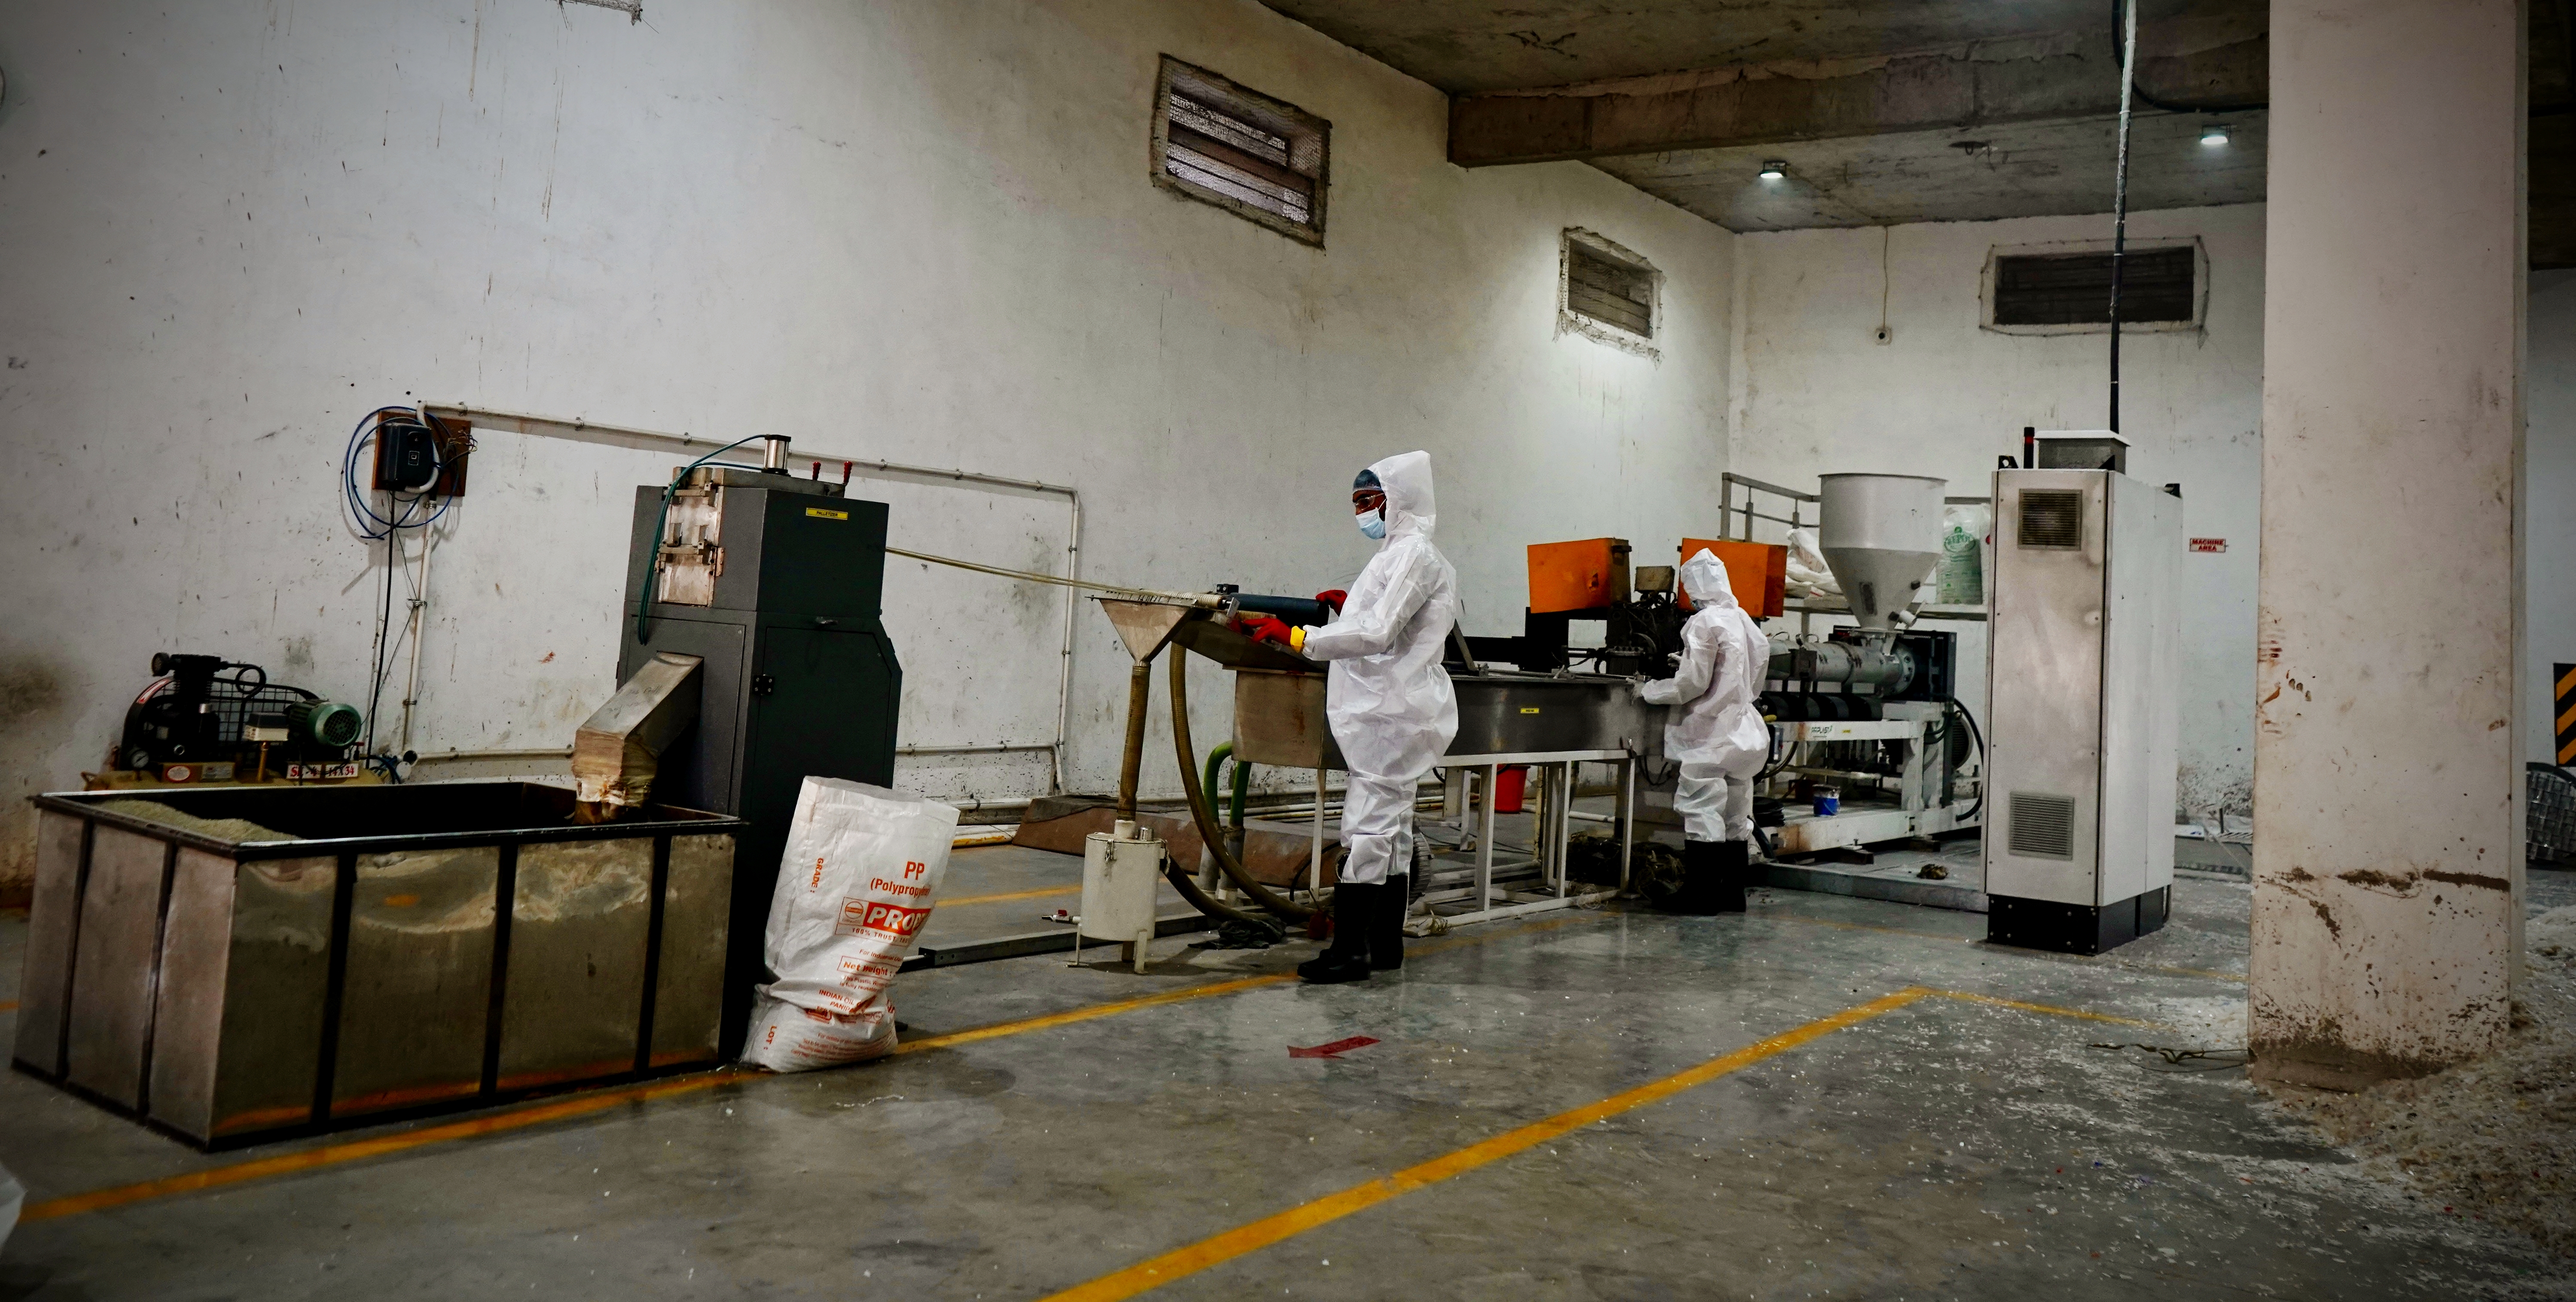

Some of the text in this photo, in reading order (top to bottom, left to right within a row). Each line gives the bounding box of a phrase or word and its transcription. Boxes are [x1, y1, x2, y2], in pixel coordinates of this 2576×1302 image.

[812, 858, 823, 888] GRADE
[904, 861, 925, 880] PP
[852, 927, 870, 936] 100%
[843, 961, 861, 971] Net
[863, 964, 888, 976] Weight
[819, 989, 854, 1005] INDIAN OIL
[766, 1025, 777, 1045] LOT
